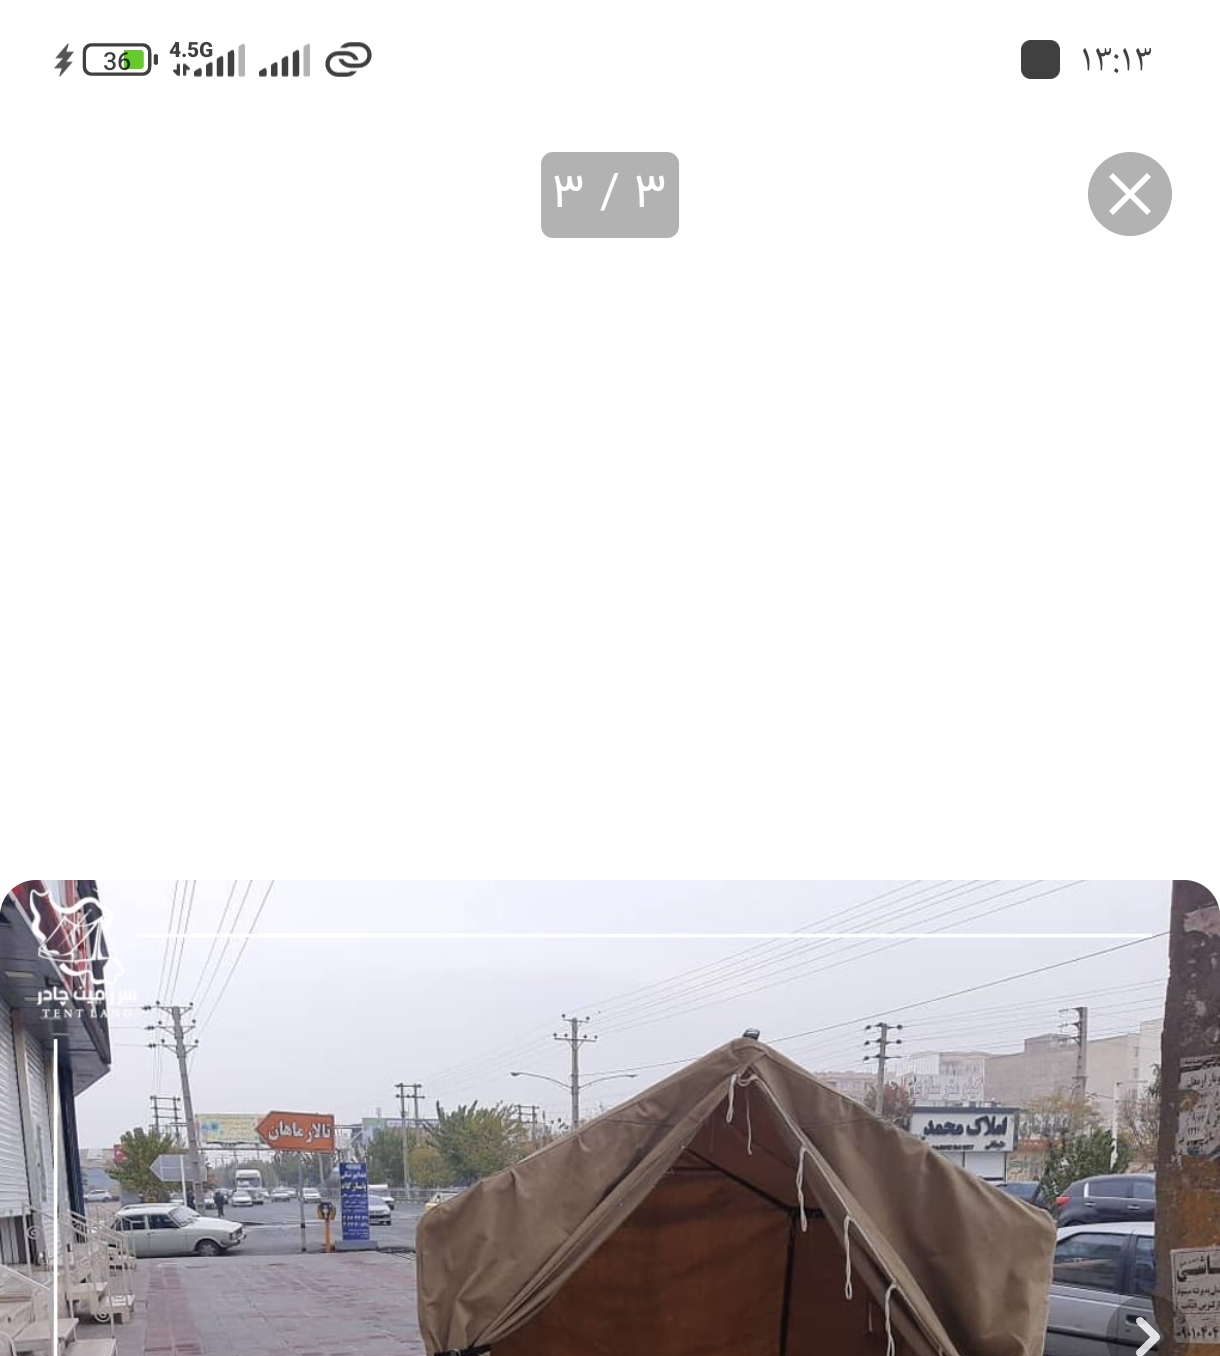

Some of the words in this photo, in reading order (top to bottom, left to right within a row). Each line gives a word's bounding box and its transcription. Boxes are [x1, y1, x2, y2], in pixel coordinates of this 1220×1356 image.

[268, 1120, 303, 1141] ماهان
[305, 1122, 331, 1143] تالار
[966, 1115, 1008, 1137] املاک
